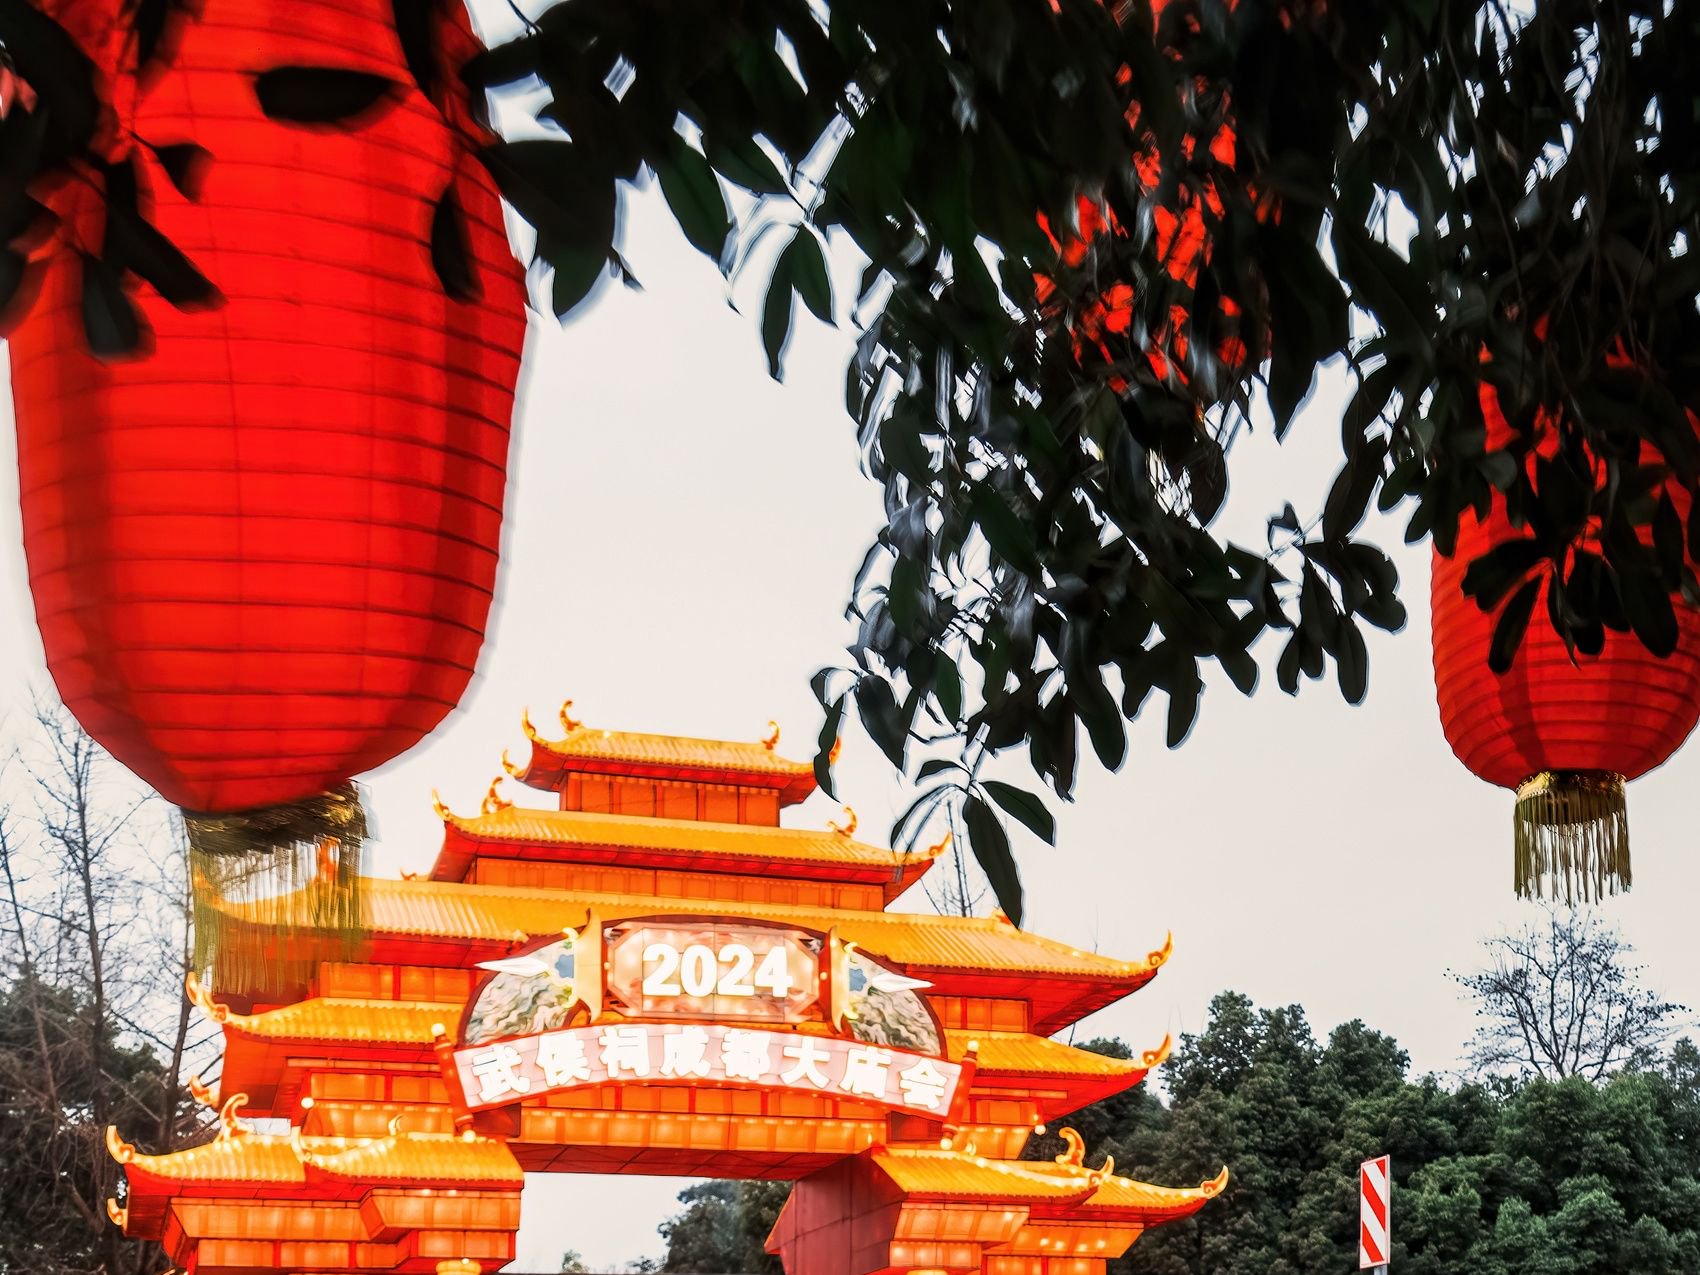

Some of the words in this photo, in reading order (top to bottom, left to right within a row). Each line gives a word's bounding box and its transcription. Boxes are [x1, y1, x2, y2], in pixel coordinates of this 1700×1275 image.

[641, 943, 794, 998] 2024
[471, 1026, 948, 1110] 武侯祠成都大庙会
